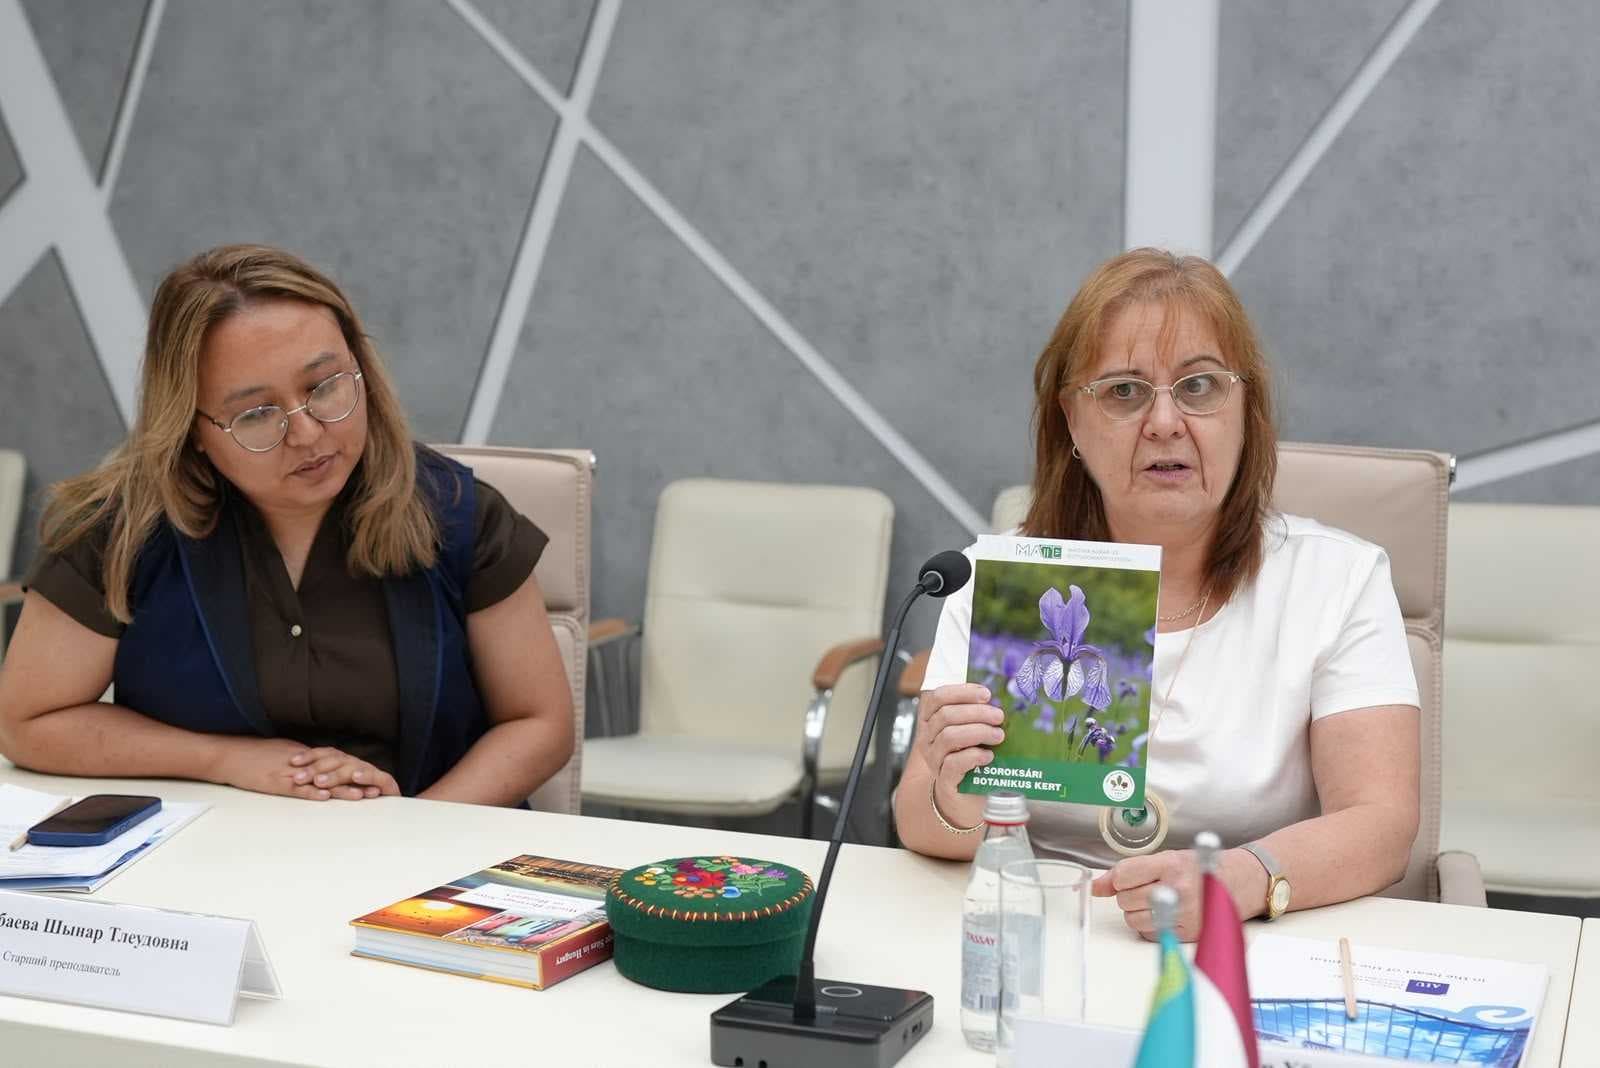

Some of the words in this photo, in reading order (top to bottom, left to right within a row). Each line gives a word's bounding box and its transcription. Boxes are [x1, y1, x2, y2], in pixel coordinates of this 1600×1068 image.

[973, 766, 981, 774] A
[983, 766, 1043, 779] SOROKSÁRI
[973, 776, 1032, 789] BOTANIKUS
[1034, 781, 1062, 792] KERT
[43, 918, 104, 943] Шынар
[109, 926, 189, 951] Тлеудовна
[3, 950, 48, 967] Старший
[50, 960, 121, 977] преподаватель
[555, 950, 582, 966] Hungary
[1415, 981, 1442, 990] AIU
